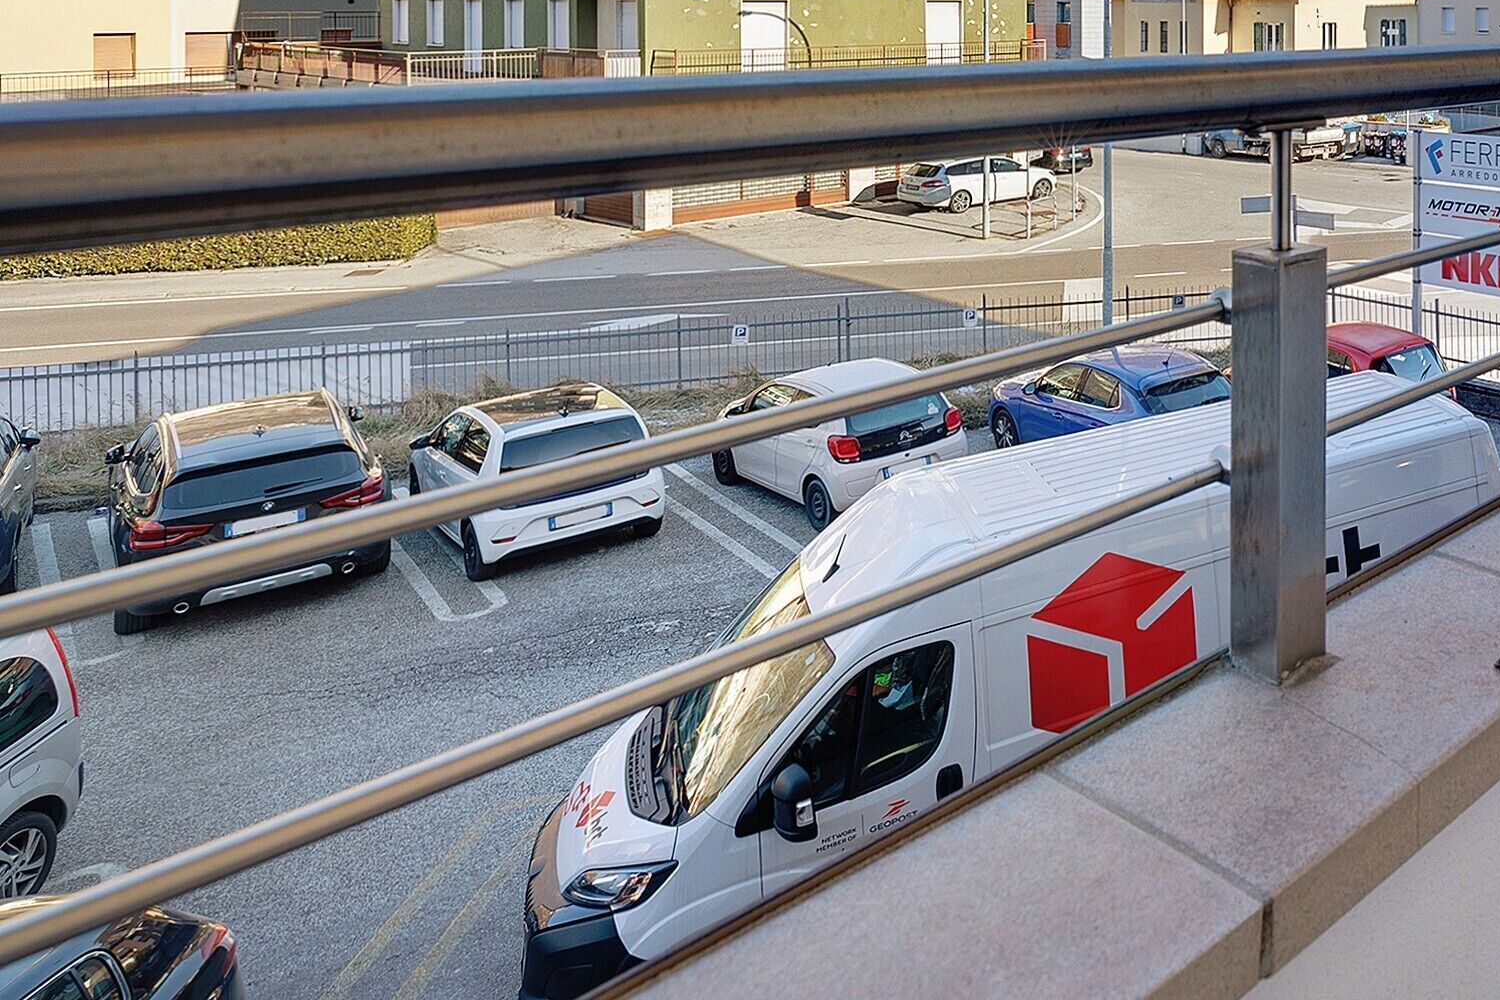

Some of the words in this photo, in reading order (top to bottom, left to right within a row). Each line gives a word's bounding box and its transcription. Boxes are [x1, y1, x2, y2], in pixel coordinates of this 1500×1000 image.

[869, 810, 918, 833] GEOPOST
[816, 838, 847, 853] MEMBER
[847, 834, 857, 843] OF
[821, 827, 857, 844] NETWORK
